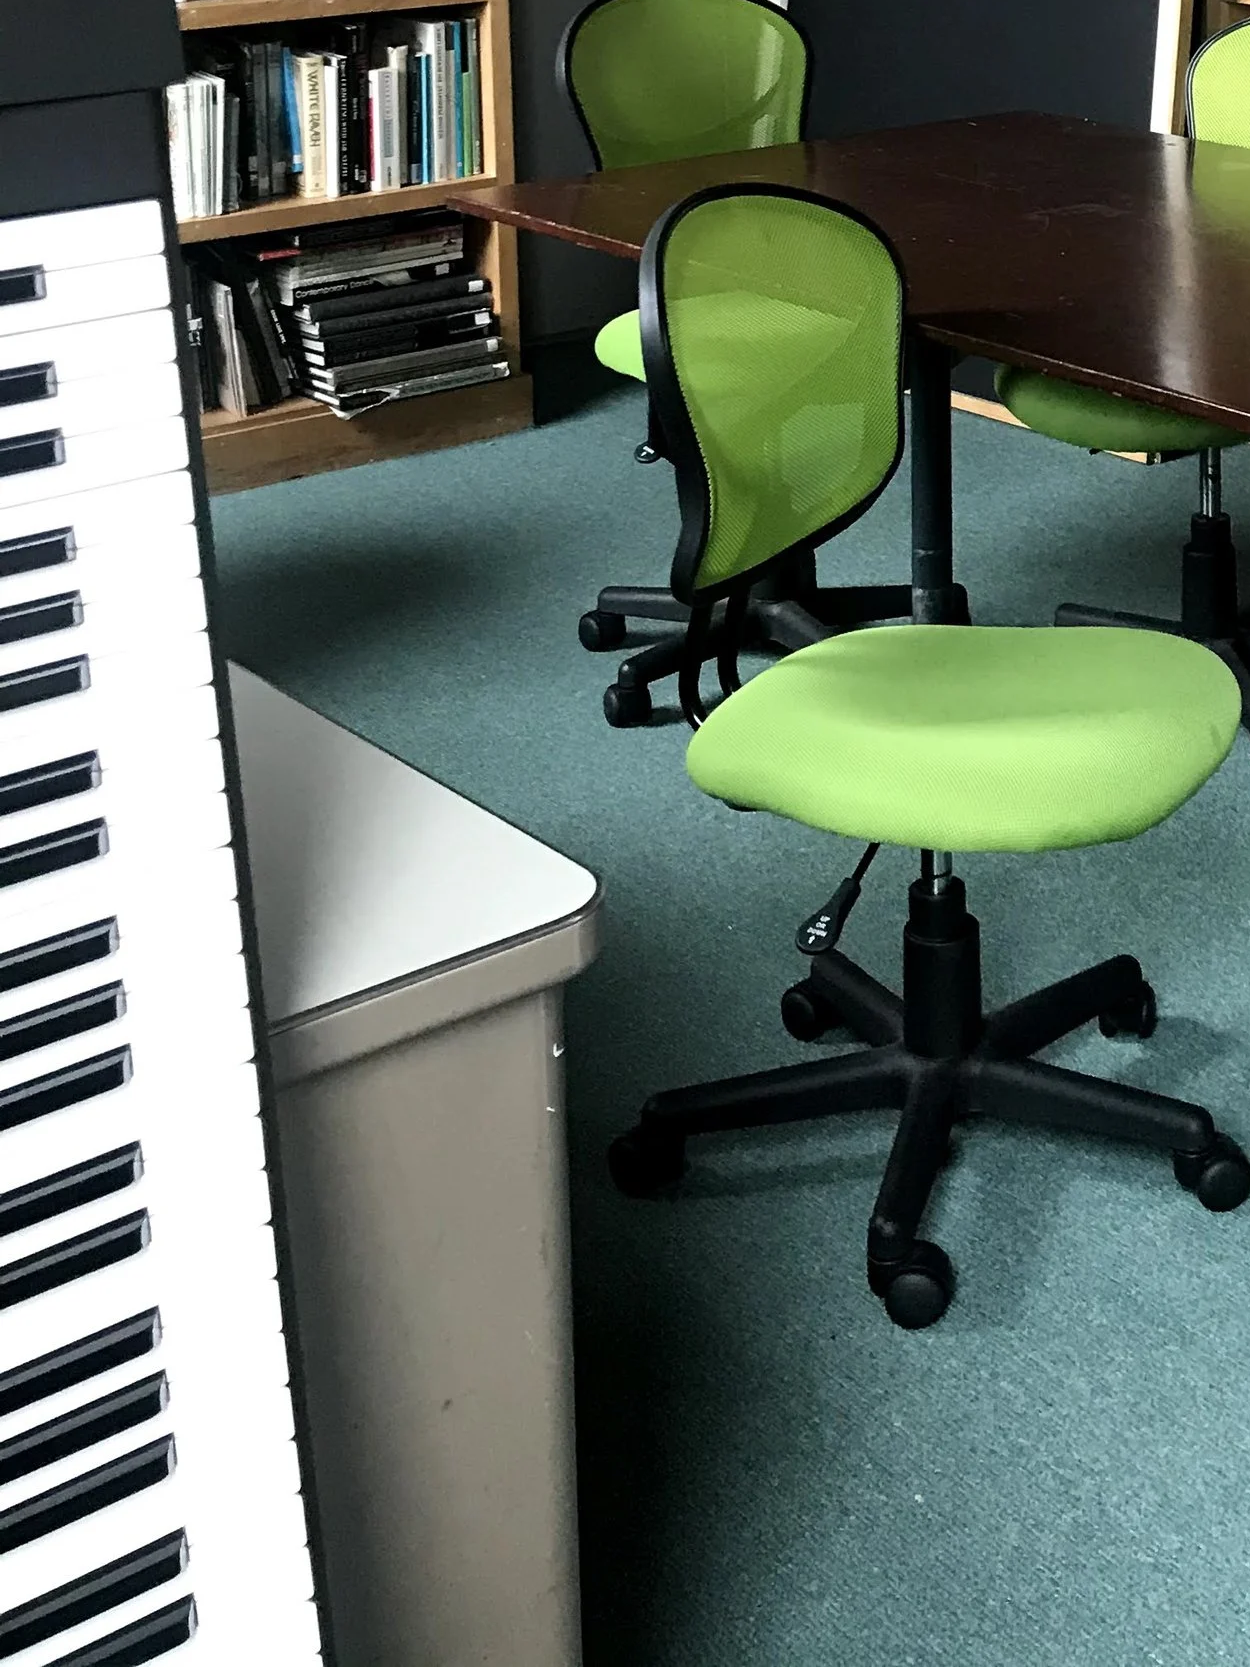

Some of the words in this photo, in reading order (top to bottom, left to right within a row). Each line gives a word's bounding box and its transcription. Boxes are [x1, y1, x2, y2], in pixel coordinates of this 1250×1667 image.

[307, 70, 319, 111] WHITE
[309, 114, 321, 147] RAVEN
[295, 284, 349, 299] Contemporary
[350, 277, 375, 289] Dance
